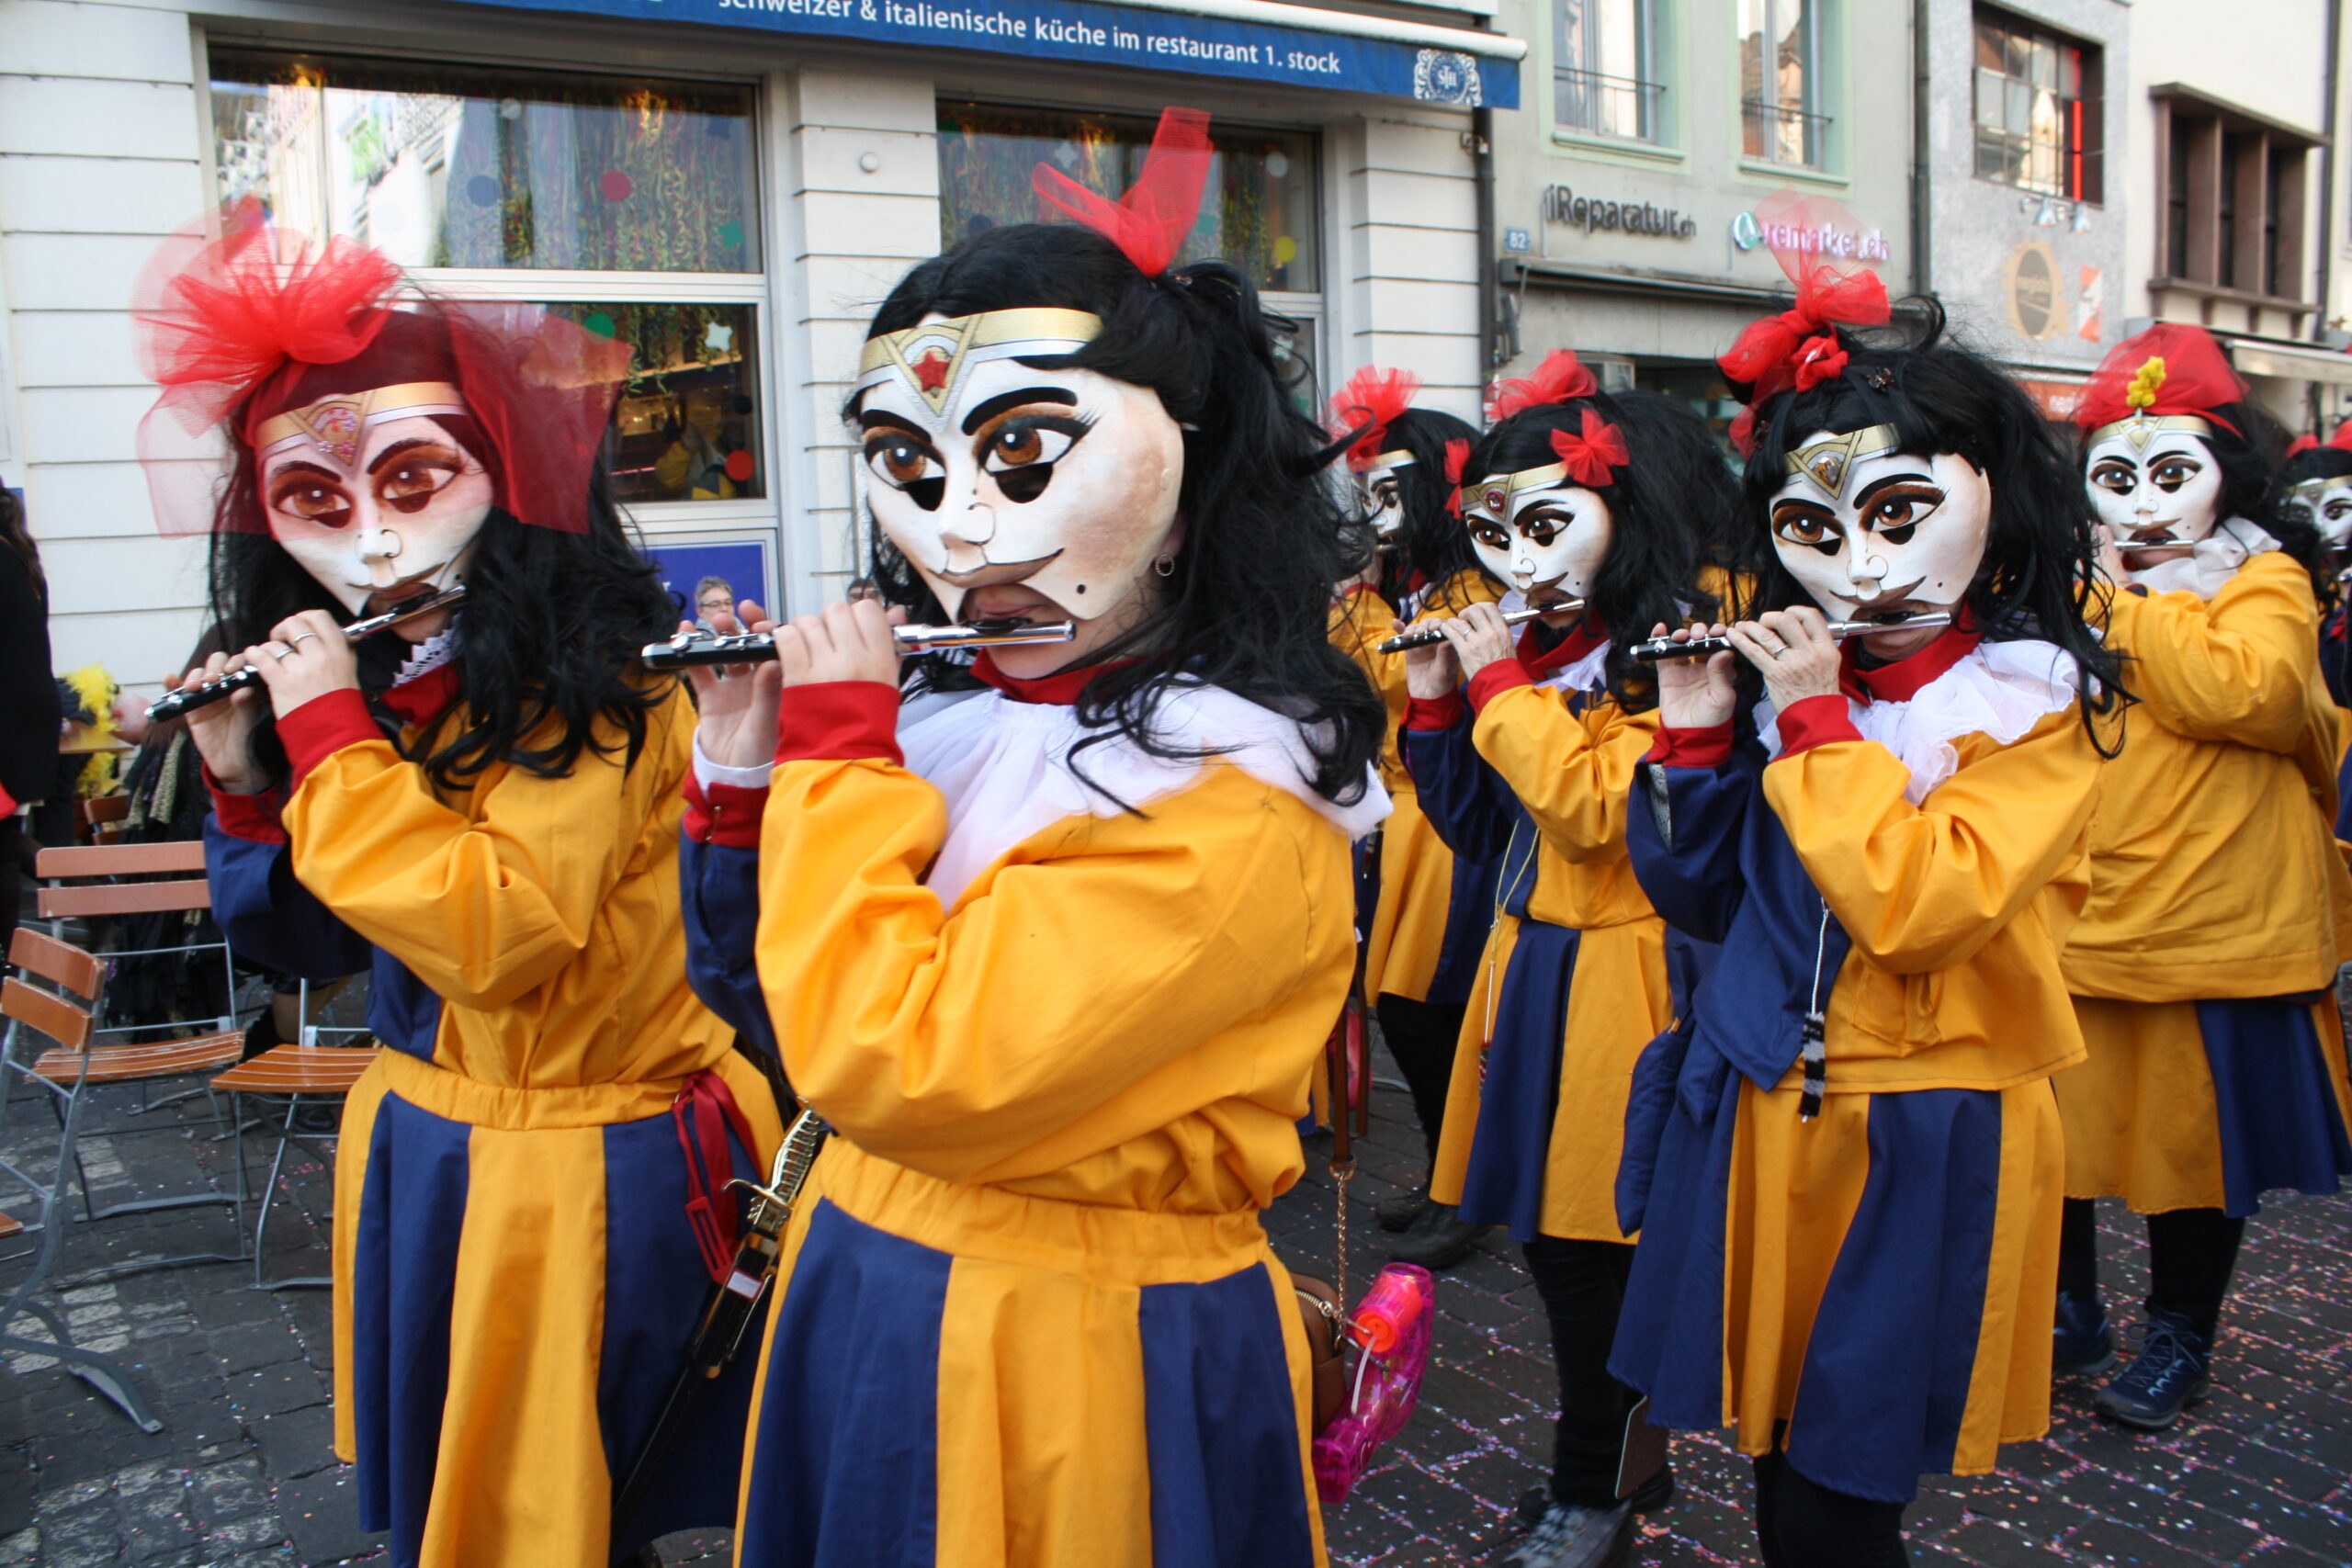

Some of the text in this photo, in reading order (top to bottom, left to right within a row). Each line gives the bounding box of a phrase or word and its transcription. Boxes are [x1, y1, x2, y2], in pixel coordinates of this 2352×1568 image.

[859, 0, 878, 21] &
[885, 0, 1027, 38] italienische
[1035, 17, 1107, 46] küche
[1113, 26, 1140, 51] im
[1147, 34, 1259, 63] restaurant
[1264, 45, 1283, 67] 1.
[1288, 51, 1342, 73] stock
[1544, 184, 1697, 237] iReparatur.ch
[1510, 231, 1527, 249] 82
